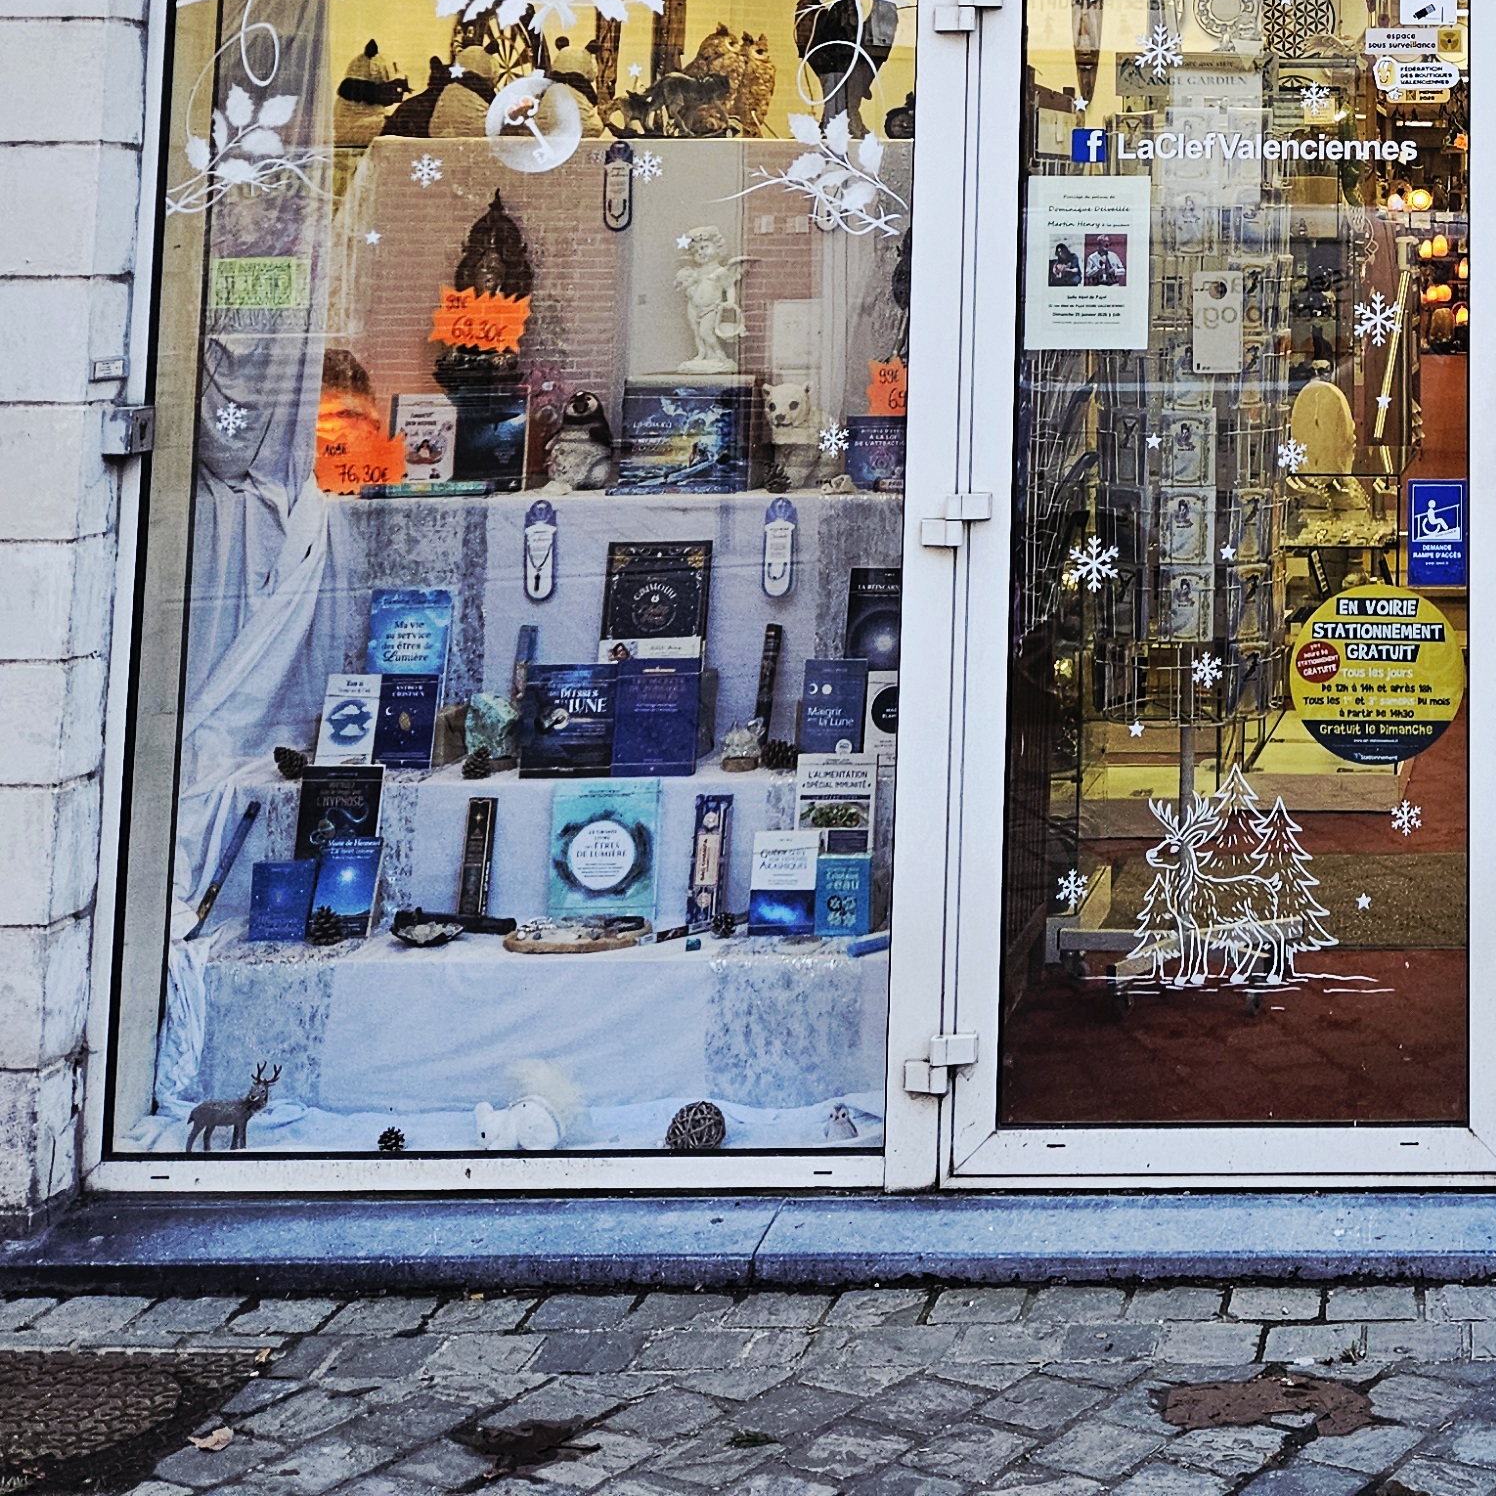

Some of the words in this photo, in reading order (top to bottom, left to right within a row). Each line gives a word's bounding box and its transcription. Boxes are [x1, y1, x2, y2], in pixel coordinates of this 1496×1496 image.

[1389, 41, 1436, 49] surveillance
[1187, 76, 1248, 85] GARDIEN
[335, 464, 392, 484] 76,30€
[1339, 599, 1359, 615] EN
[1365, 599, 1417, 616] VOIRIE
[394, 620, 407, 629] Ma
[409, 621, 425, 629] vie
[397, 631, 432, 640] service
[1313, 623, 1443, 639] STATIONNEMENT
[382, 650, 429, 663] Lumière
[1346, 644, 1416, 660] GRATUIT
[1297, 654, 1339, 668] STATIONNEMENT
[1303, 664, 1337, 677] GRATUITE
[1342, 667, 1366, 678] Tous
[1368, 667, 1384, 678] les
[1386, 667, 1413, 681] jours
[1335, 683, 1349, 693] 12h
[1360, 683, 1374, 693] 14h
[1377, 684, 1387, 693] et
[1390, 682, 1416, 693] après
[1303, 696, 1325, 705] Tous
[1326, 696, 1340, 705] les
[1355, 696, 1365, 705] et
[1429, 696, 1450, 706] mois
[1389, 709, 1415, 718] 14h30
[830, 717, 855, 727] Lune
[1319, 724, 1361, 735] Gratuit
[1365, 723, 1376, 735] le
[1380, 724, 1433, 736] Dimanche
[808, 770, 868, 779] L'ALIMENTATION
